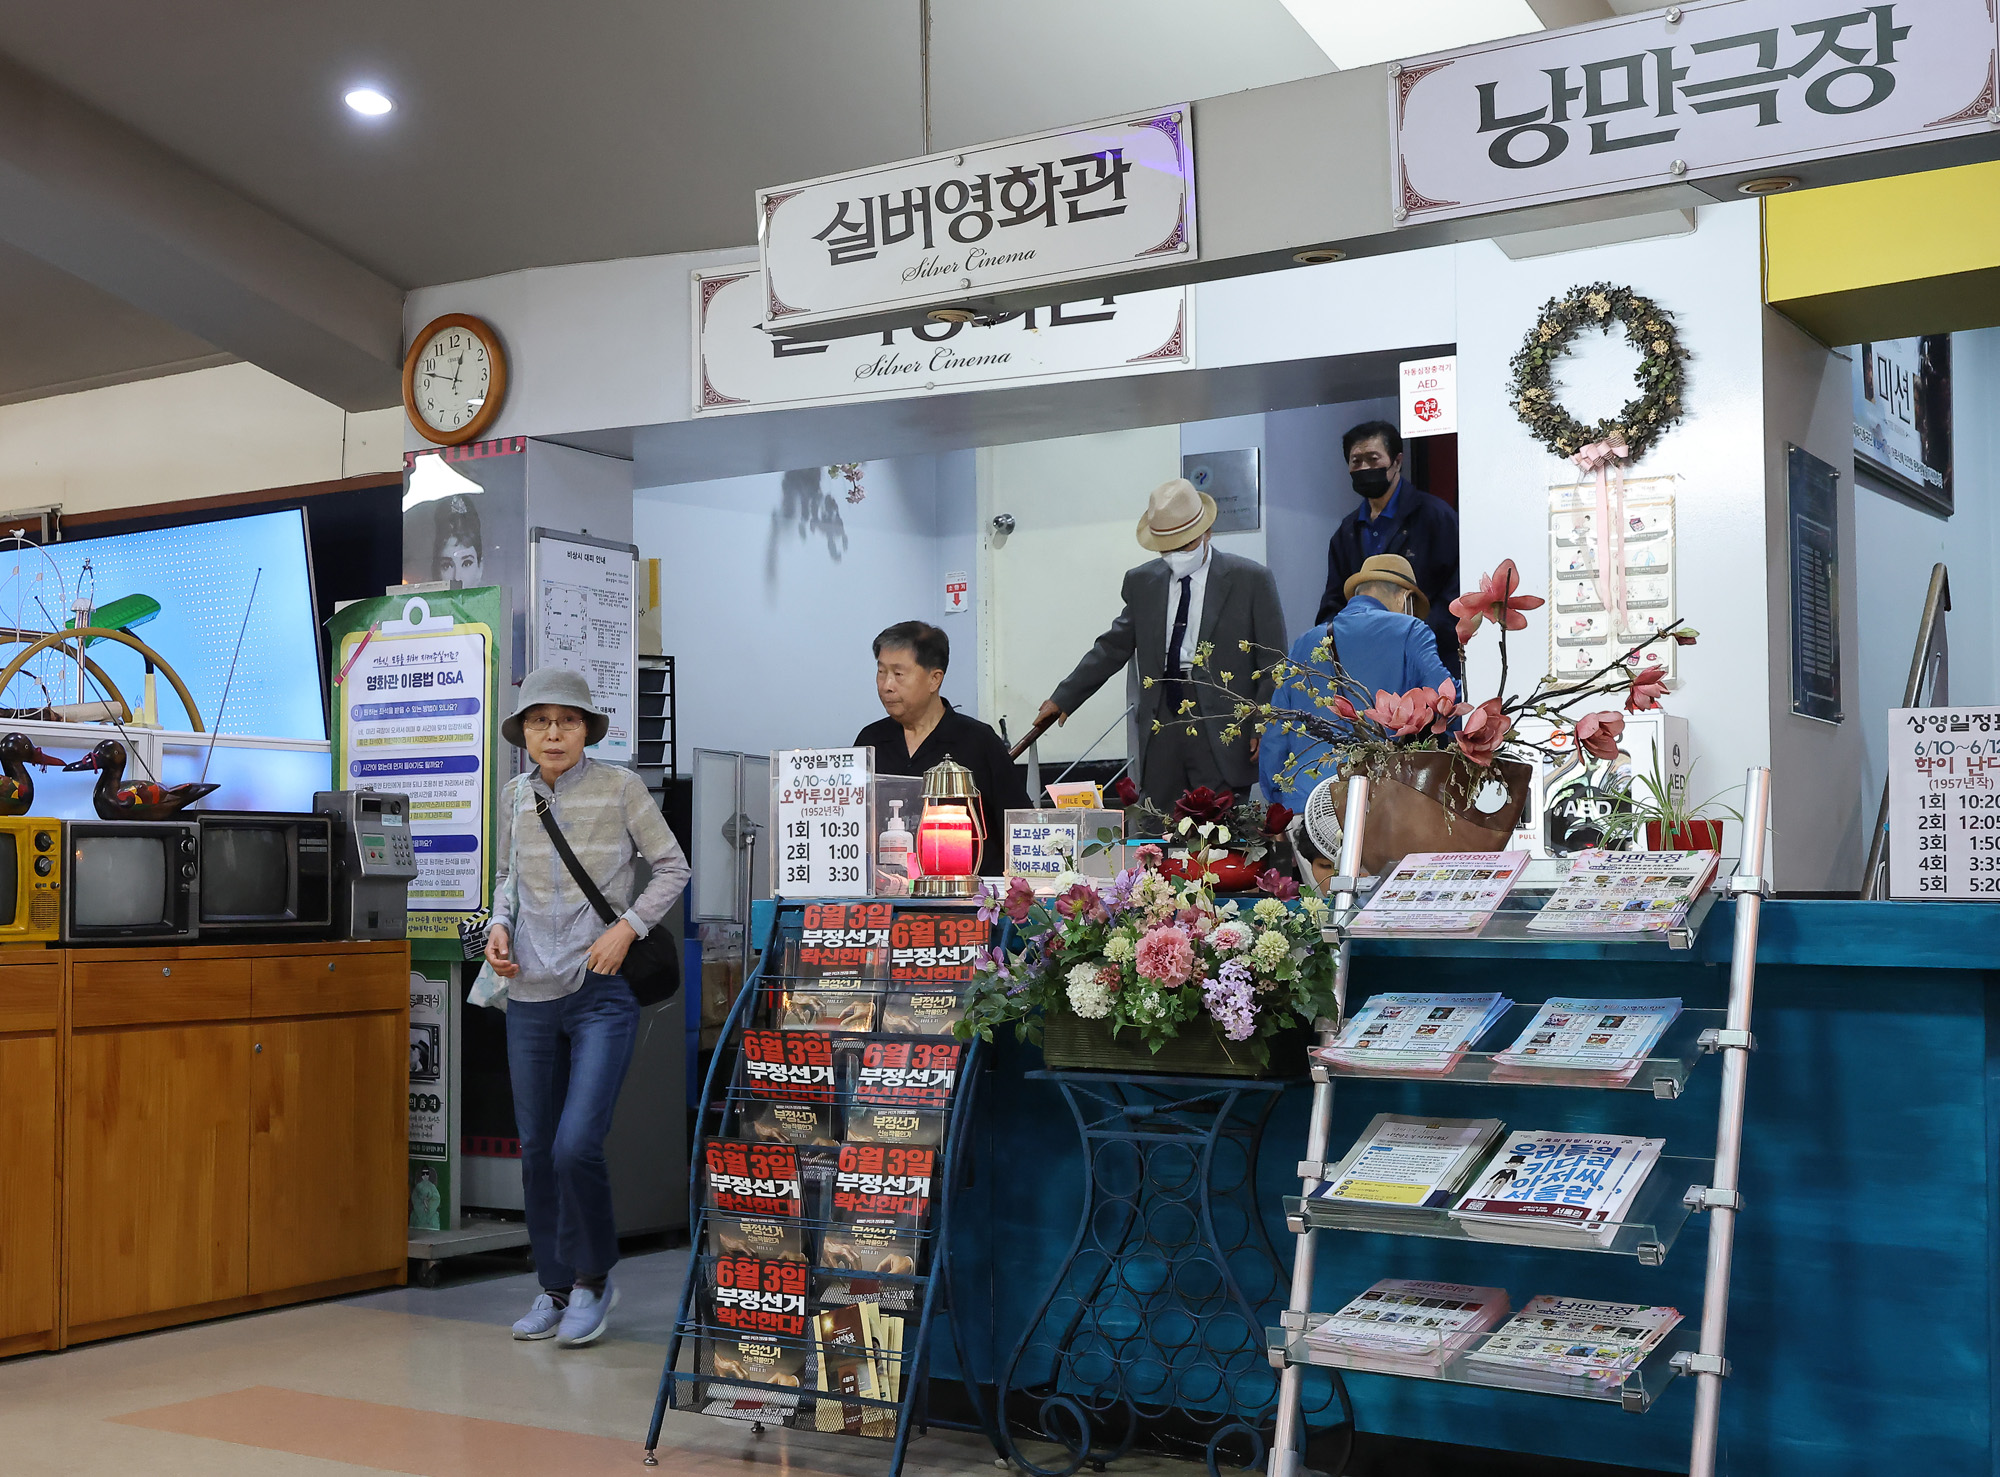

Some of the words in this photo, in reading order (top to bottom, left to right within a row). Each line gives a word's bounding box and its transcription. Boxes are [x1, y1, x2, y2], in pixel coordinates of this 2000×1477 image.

[1475, 4, 1914, 169] 낭만극장
[812, 147, 1134, 267] 실버영화관
[902, 256, 961, 285] Silver
[964, 246, 1037, 275] Cinema
[434, 343, 444, 357] 11
[449, 334, 460, 348] 12
[467, 337, 472, 350] 1
[477, 348, 484, 362] 2
[425, 358, 436, 372] 10
[854, 353, 923, 383] Silver
[928, 346, 1012, 374] Cinema
[481, 367, 488, 382] 3
[423, 378, 430, 391] 9
[1418, 379, 1438, 389] AED
[1877, 354, 1911, 424] 미션
[427, 398, 434, 410] 8
[466, 405, 474, 418] 5
[438, 410, 445, 423] 7
[453, 412, 460, 425] 6
[566, 550, 583, 561] 비상시
[595, 555, 606, 565] 안내
[367, 674, 398, 691] 영화관
[401, 672, 433, 689] 이용법
[437, 670, 464, 687] Q&A
[1907, 714, 2000, 734] 상영일정
[789, 754, 855, 770] 상영일정표
[1914, 756, 1954, 778] 학이
[792, 773, 853, 788] 6/10~6/12
[1929, 776, 1994, 790] (1957년작)
[1919, 793, 1946, 811] 1회
[800, 807, 845, 818] (1952년작)
[787, 821, 811, 839] 1회
[820, 821, 860, 839] 10:30
[1918, 813, 1946, 831] 2회
[1012, 828, 1051, 841] 보고싶은
[1919, 834, 1947, 852] 3회
[787, 843, 811, 862] 2회
[828, 844, 860, 860] 1:00
[1012, 844, 1047, 857] 듣고싶
[1605, 853, 1684, 864] 낭만극장
[1013, 861, 1061, 874] 적어주세요
[1918, 854, 1947, 872] 4회
[787, 866, 811, 884] 3회
[828, 866, 860, 883] 3:30
[1919, 875, 1947, 893] 5회
[803, 904, 846, 929] 6월
[851, 904, 893, 928] 3일
[801, 929, 891, 948] 부정선거
[891, 921, 935, 947] 6월
[940, 920, 984, 944] 3일
[910, 996, 957, 1008] 부정선거
[744, 1036, 783, 1061] 6월
[787, 1037, 831, 1066] 3일
[862, 1043, 910, 1068] 6월
[912, 1044, 960, 1070] 3일
[747, 1060, 835, 1086] 부정선거
[858, 1067, 955, 1089] 부정선거
[773, 1109, 818, 1125] 부정선거
[872, 1116, 920, 1131] 부정선거
[1509, 1143, 1622, 1159] 우리들의
[706, 1150, 748, 1176] 6월
[750, 1154, 796, 1180] 3일
[838, 1147, 883, 1174] 6월
[887, 1149, 933, 1178] 3일
[1523, 1155, 1614, 1175] 키다리
[710, 1173, 800, 1198] 부정선거
[836, 1172, 931, 1198] 부정선거
[1503, 1182, 1596, 1205] 서울런
[716, 1261, 760, 1288] 6월
[763, 1264, 806, 1294] 3일
[717, 1286, 805, 1315] 부정선거
[1553, 1300, 1636, 1316] 낭만극장
[717, 1307, 806, 1335] 확신한다!
